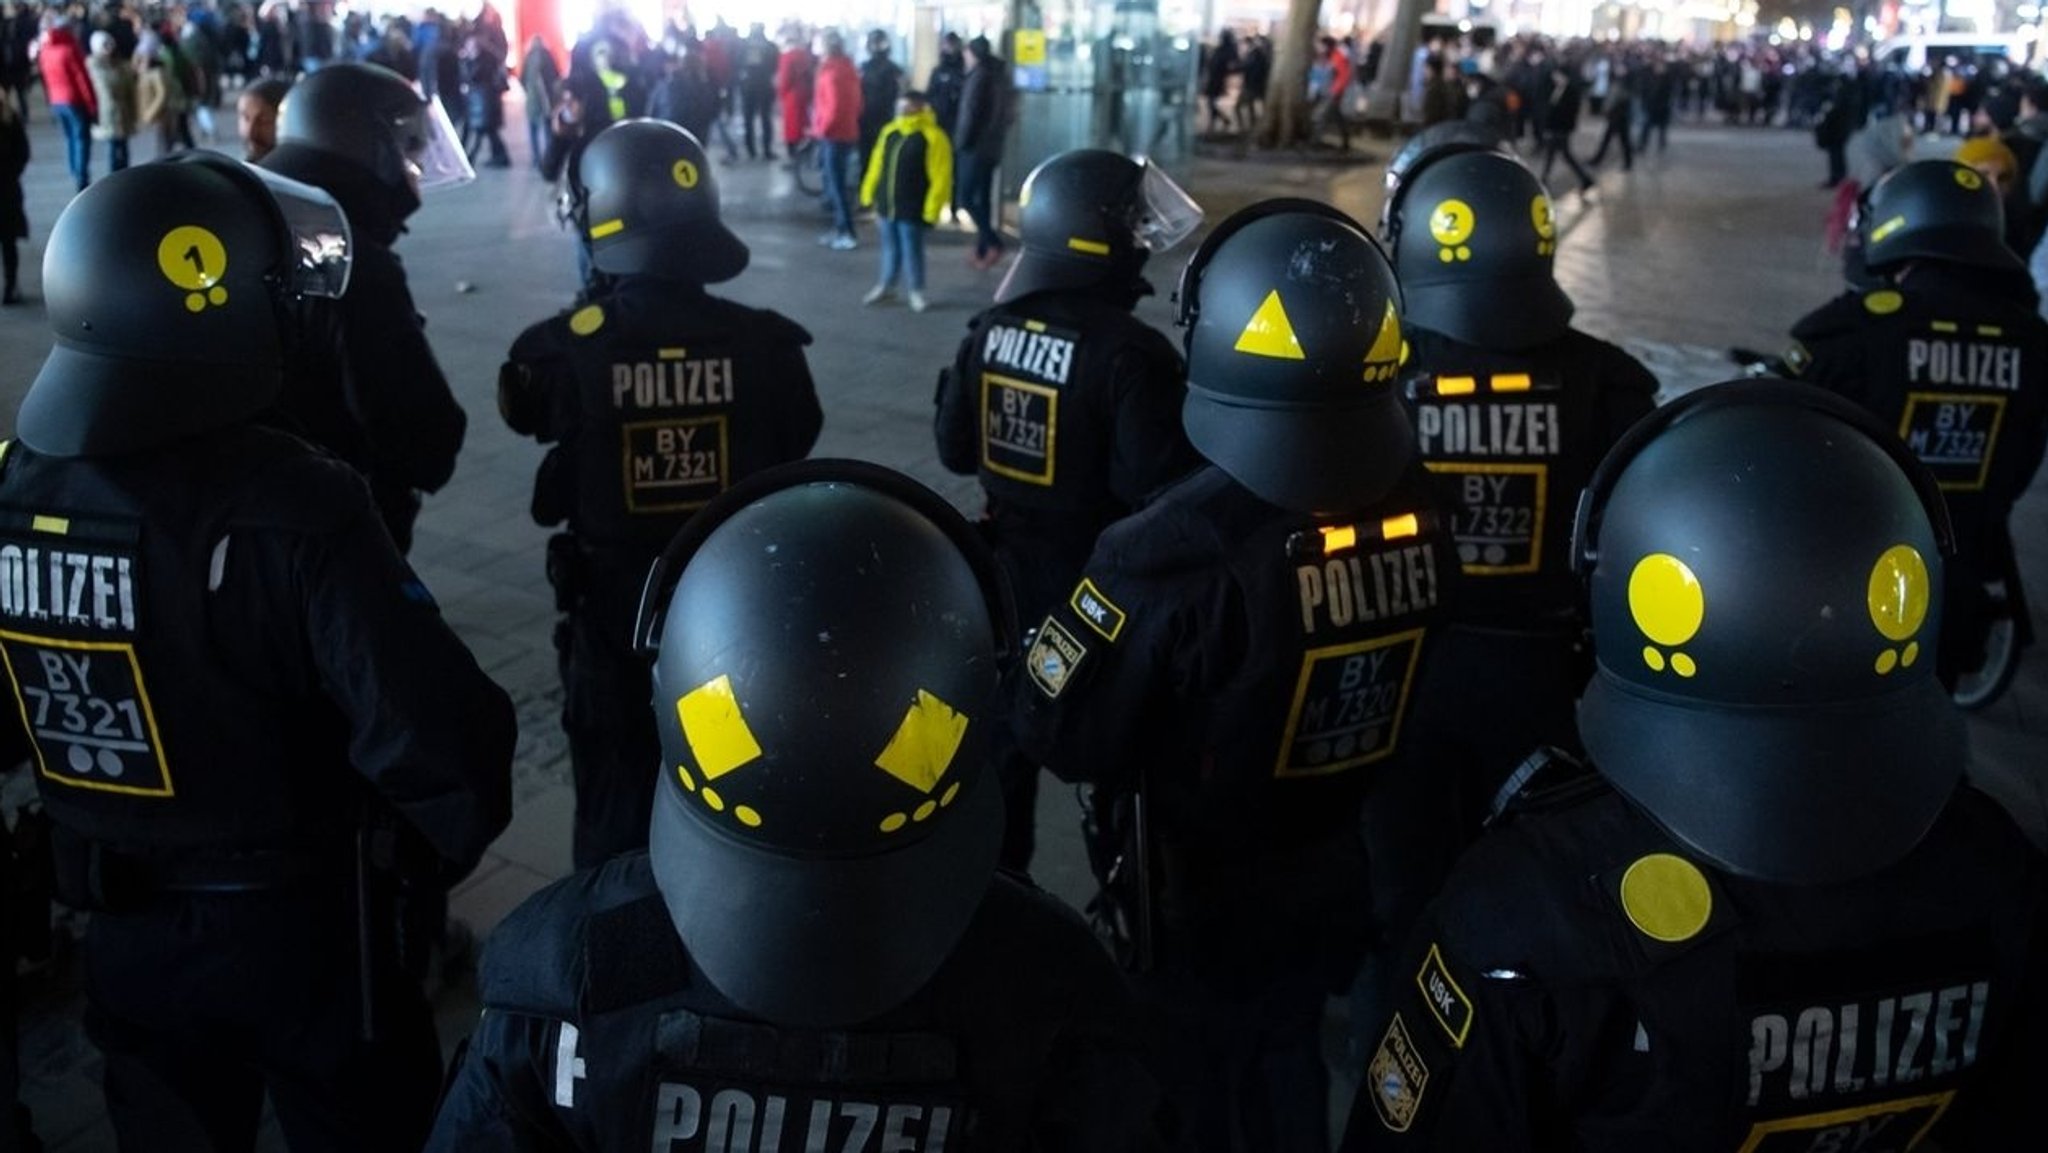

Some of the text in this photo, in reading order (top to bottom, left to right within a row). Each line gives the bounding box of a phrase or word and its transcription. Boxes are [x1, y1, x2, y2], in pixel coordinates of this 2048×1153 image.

[184, 246, 206, 278] 1
[982, 324, 1075, 385] POLIZEI
[1908, 338, 2022, 391] POLIZEI
[612, 357, 734, 408] POLIZEI
[1002, 387, 1033, 418] BY
[1005, 416, 1047, 450] 7321
[1418, 403, 1560, 455] POLIZEI
[1934, 403, 1976, 430] BY
[656, 426, 697, 453] BY
[634, 450, 717, 480] M 7321
[1463, 475, 1509, 504] BY
[1467, 506, 1532, 535] 7322
[1081, 593, 1107, 624] USK
[1297, 543, 1438, 634] POLIZEI
[38, 650, 91, 695] BY
[1339, 648, 1391, 690] BY
[24, 686, 145, 740] 7321
[1334, 680, 1398, 726] 7320
[1428, 970, 1455, 1017] USK
[1746, 980, 1990, 1107] POLIZEI
[652, 1082, 952, 1153] POLIZEI
